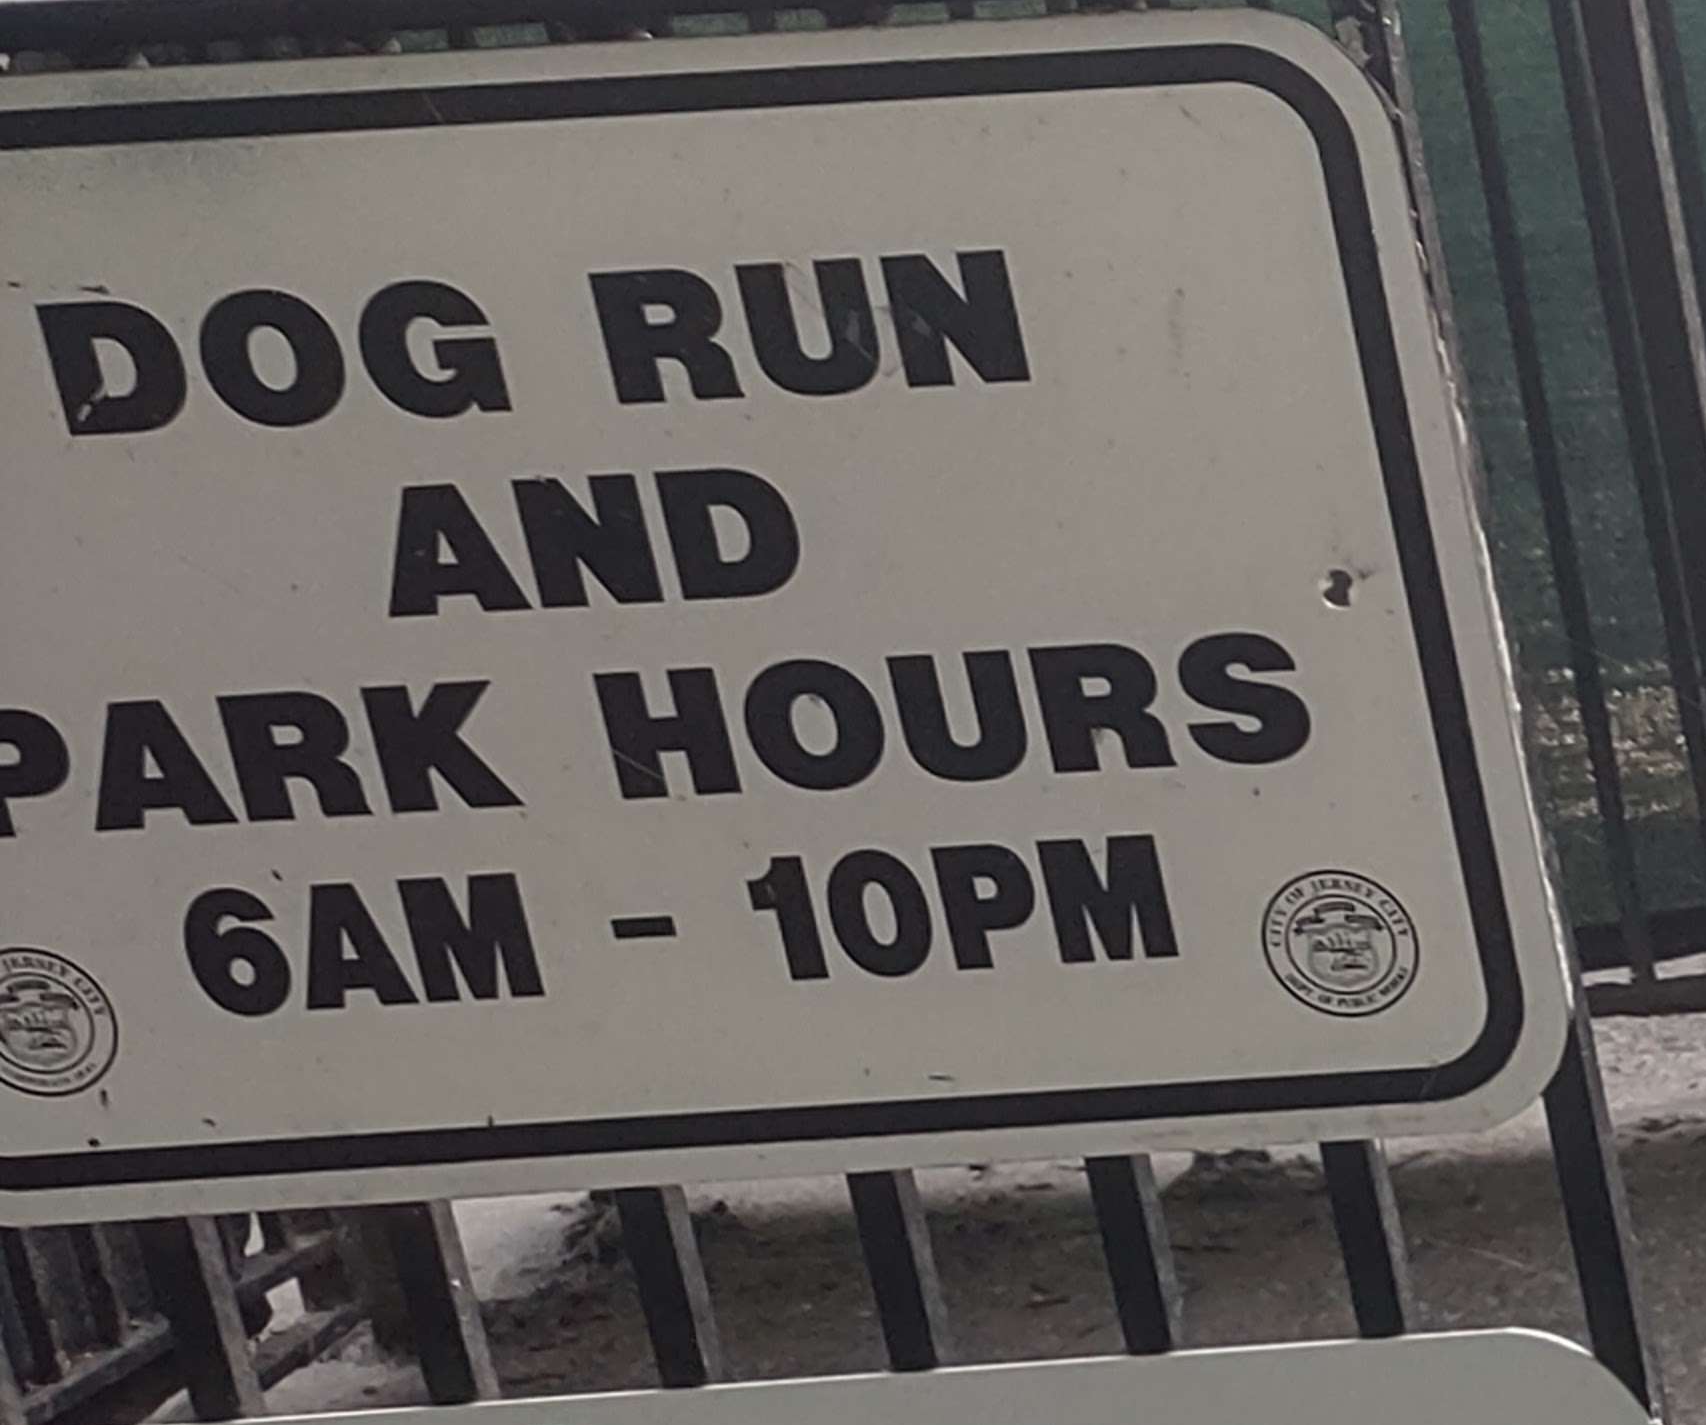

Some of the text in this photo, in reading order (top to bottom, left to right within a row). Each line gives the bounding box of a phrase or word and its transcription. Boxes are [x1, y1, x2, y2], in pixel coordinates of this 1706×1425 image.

[35, 248, 1033, 437] DOG RUN
[387, 467, 802, 618] AND
[0, 632, 1313, 838] PARK HOURS
[182, 833, 1180, 1018] 6AM - 10PM
